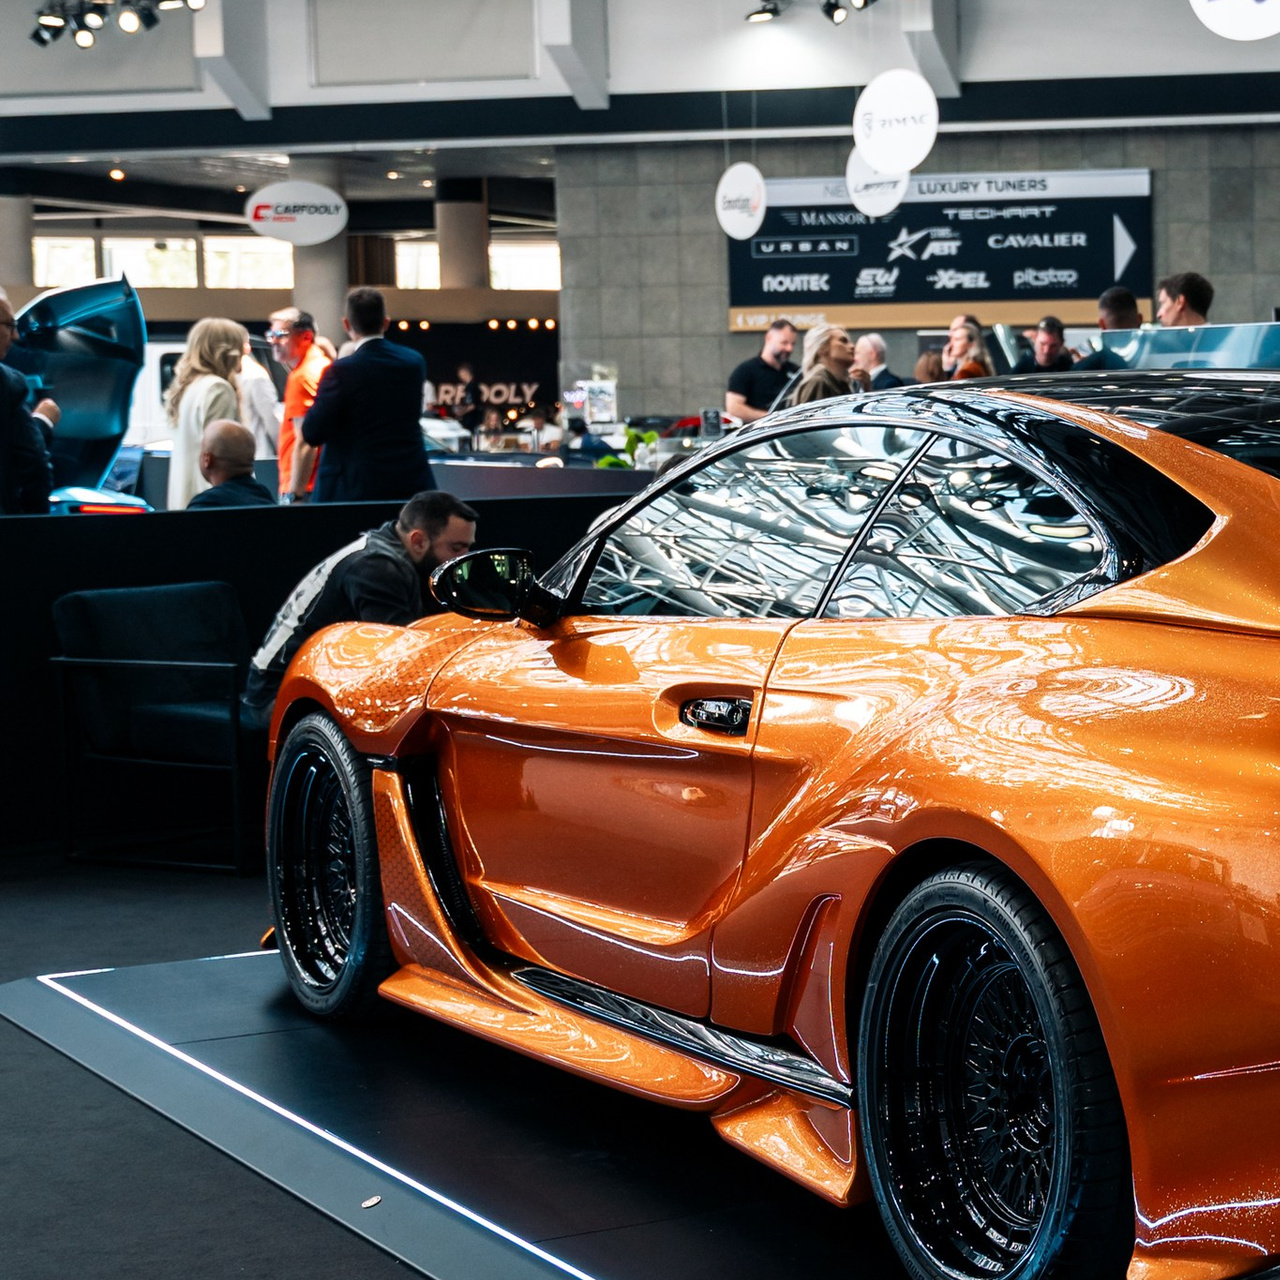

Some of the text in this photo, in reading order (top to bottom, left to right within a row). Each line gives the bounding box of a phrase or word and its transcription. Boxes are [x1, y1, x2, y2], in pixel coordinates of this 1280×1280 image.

[918, 180, 980, 195] LUXURY
[986, 178, 1048, 193] TUNERS
[942, 205, 1058, 221] TECHART
[760, 239, 850, 253] URBAN
[986, 230, 1088, 249] CAVALIER
[762, 273, 830, 293] NOVITEC
[933, 268, 991, 289] XPEL
[745, 313, 768, 327] VIP
